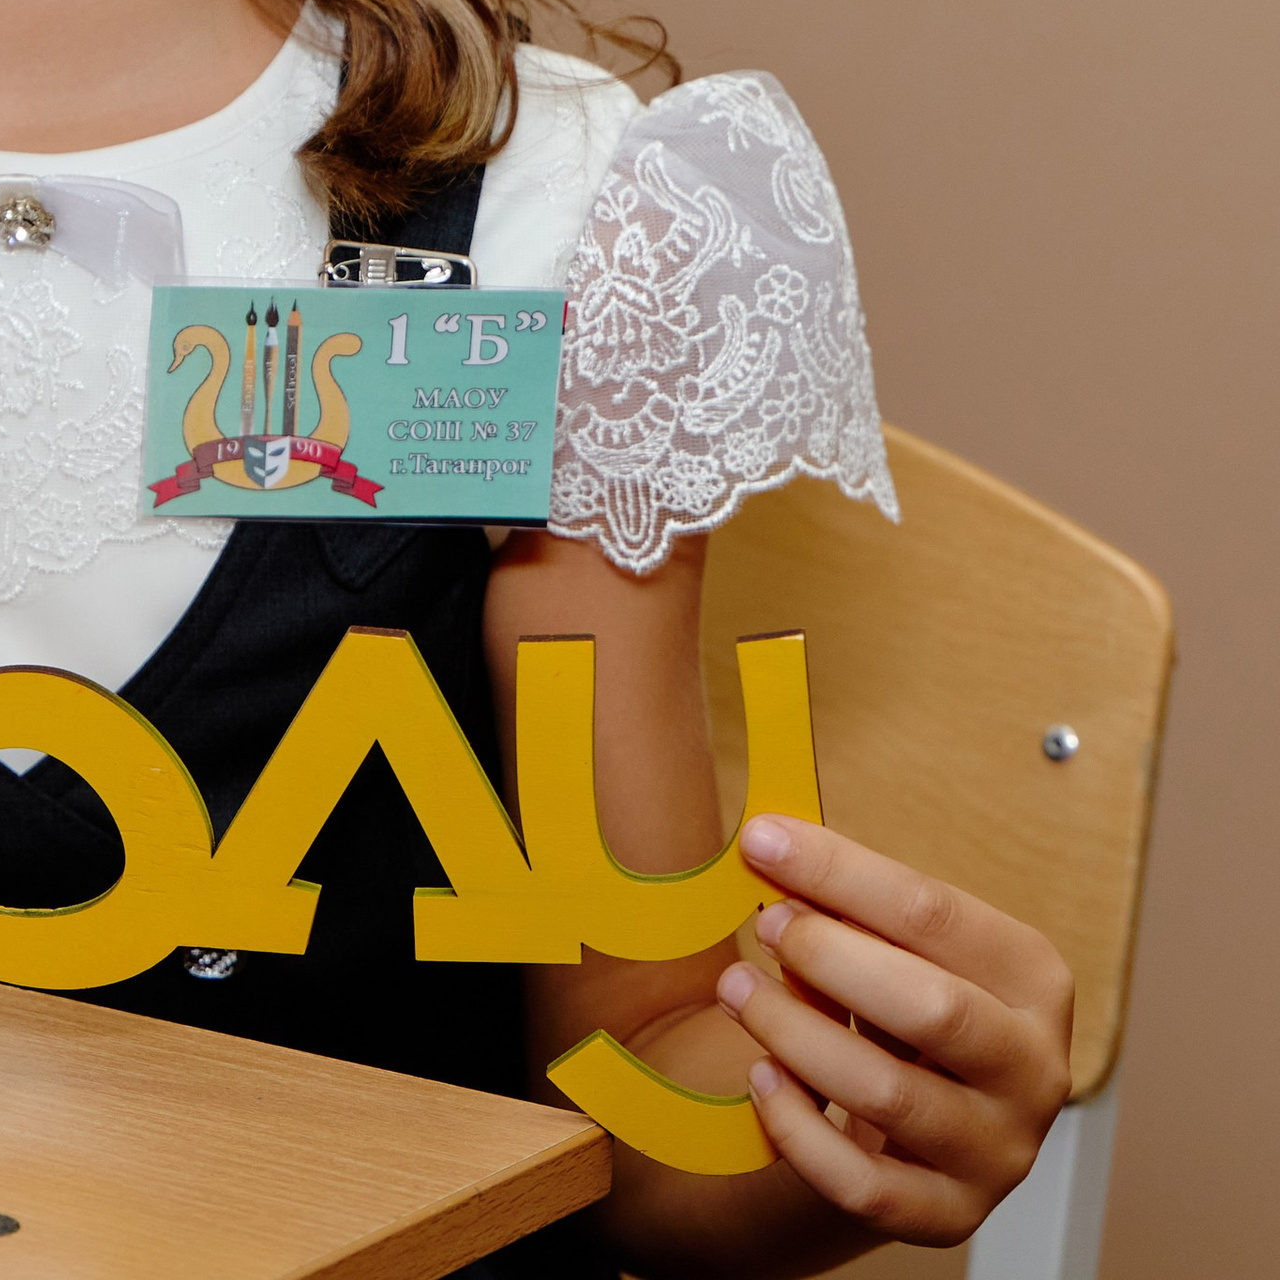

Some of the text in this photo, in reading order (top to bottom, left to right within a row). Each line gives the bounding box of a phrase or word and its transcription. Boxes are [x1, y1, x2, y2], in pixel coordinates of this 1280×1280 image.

[385, 312, 410, 366] 1
[285, 353, 298, 409] school
[413, 387, 508, 409] МАОУ
[388, 420, 538, 441] СОШ № 37
